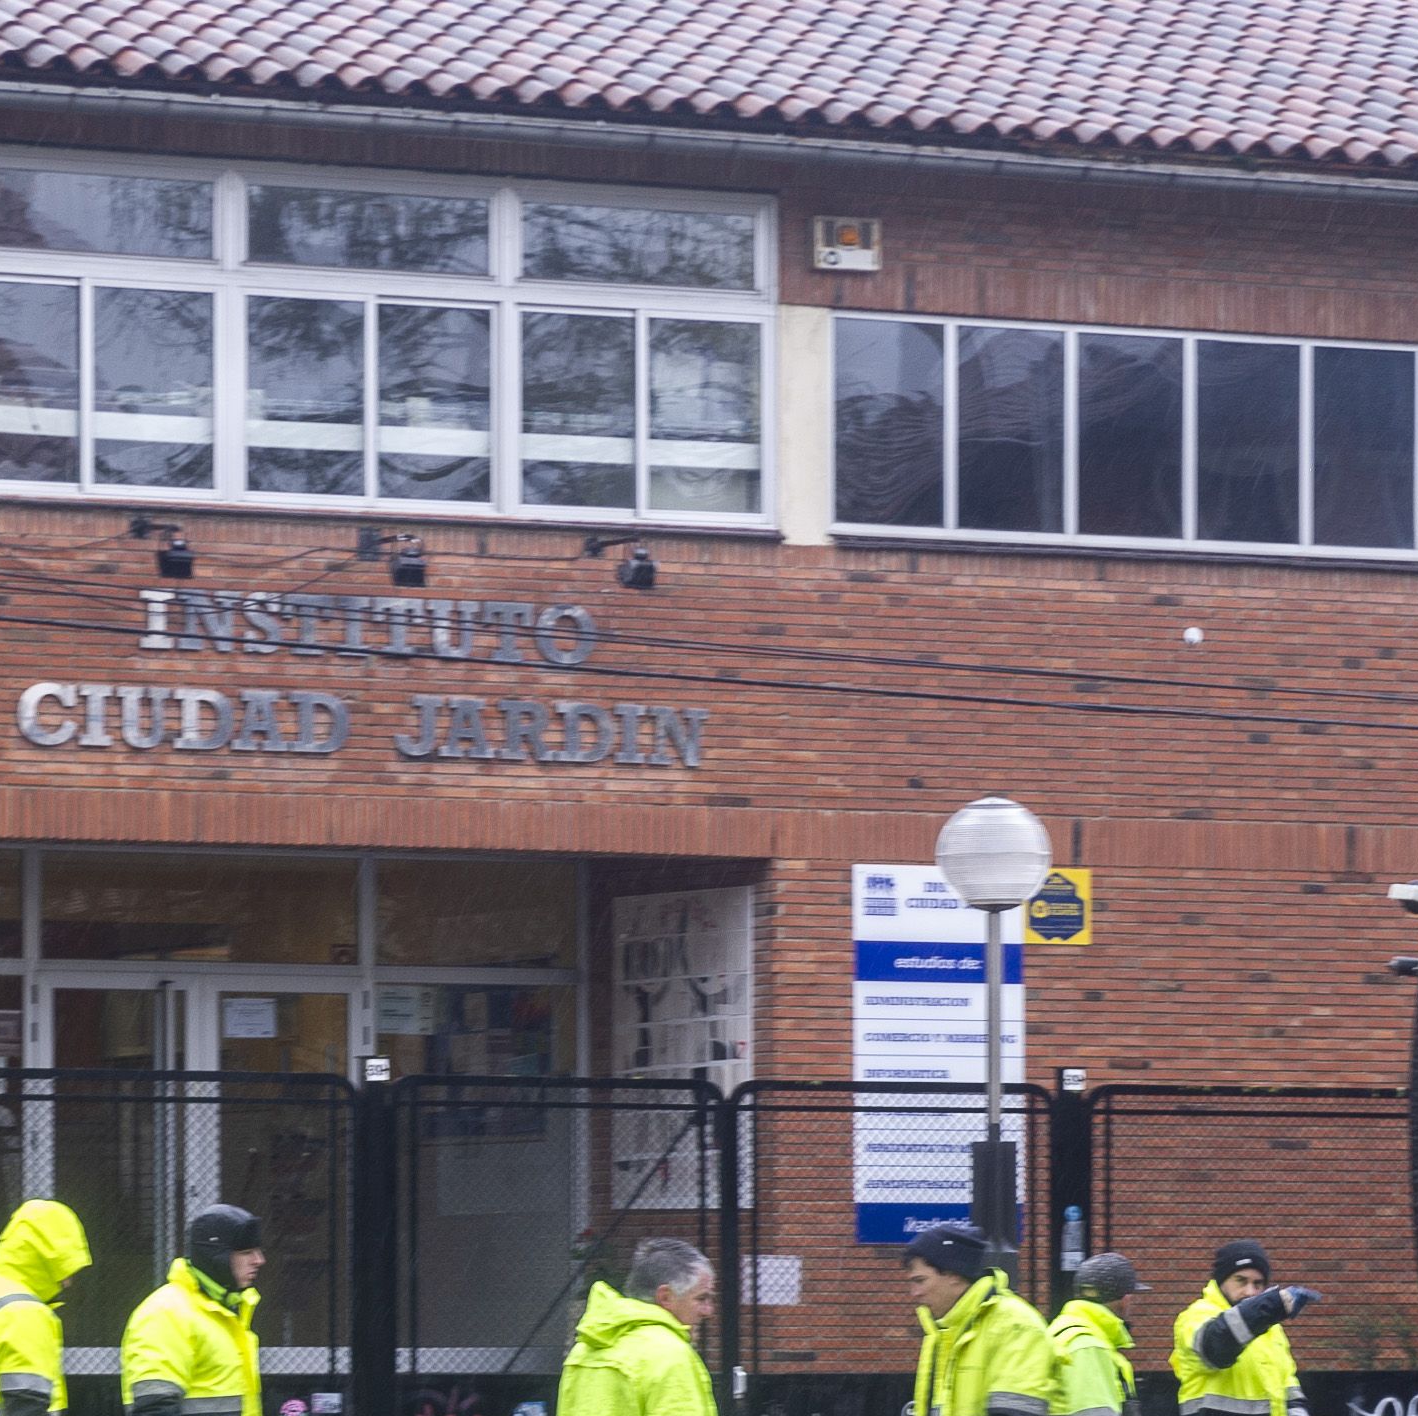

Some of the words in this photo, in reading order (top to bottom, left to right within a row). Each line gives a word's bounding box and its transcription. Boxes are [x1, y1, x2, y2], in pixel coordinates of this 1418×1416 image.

[139, 588, 597, 665] INSTITUTO
[16, 682, 350, 753] CIUDAD
[384, 694, 711, 767] JARDIN
[905, 898, 958, 909] CIUDAD
[893, 956, 957, 969] estudios
